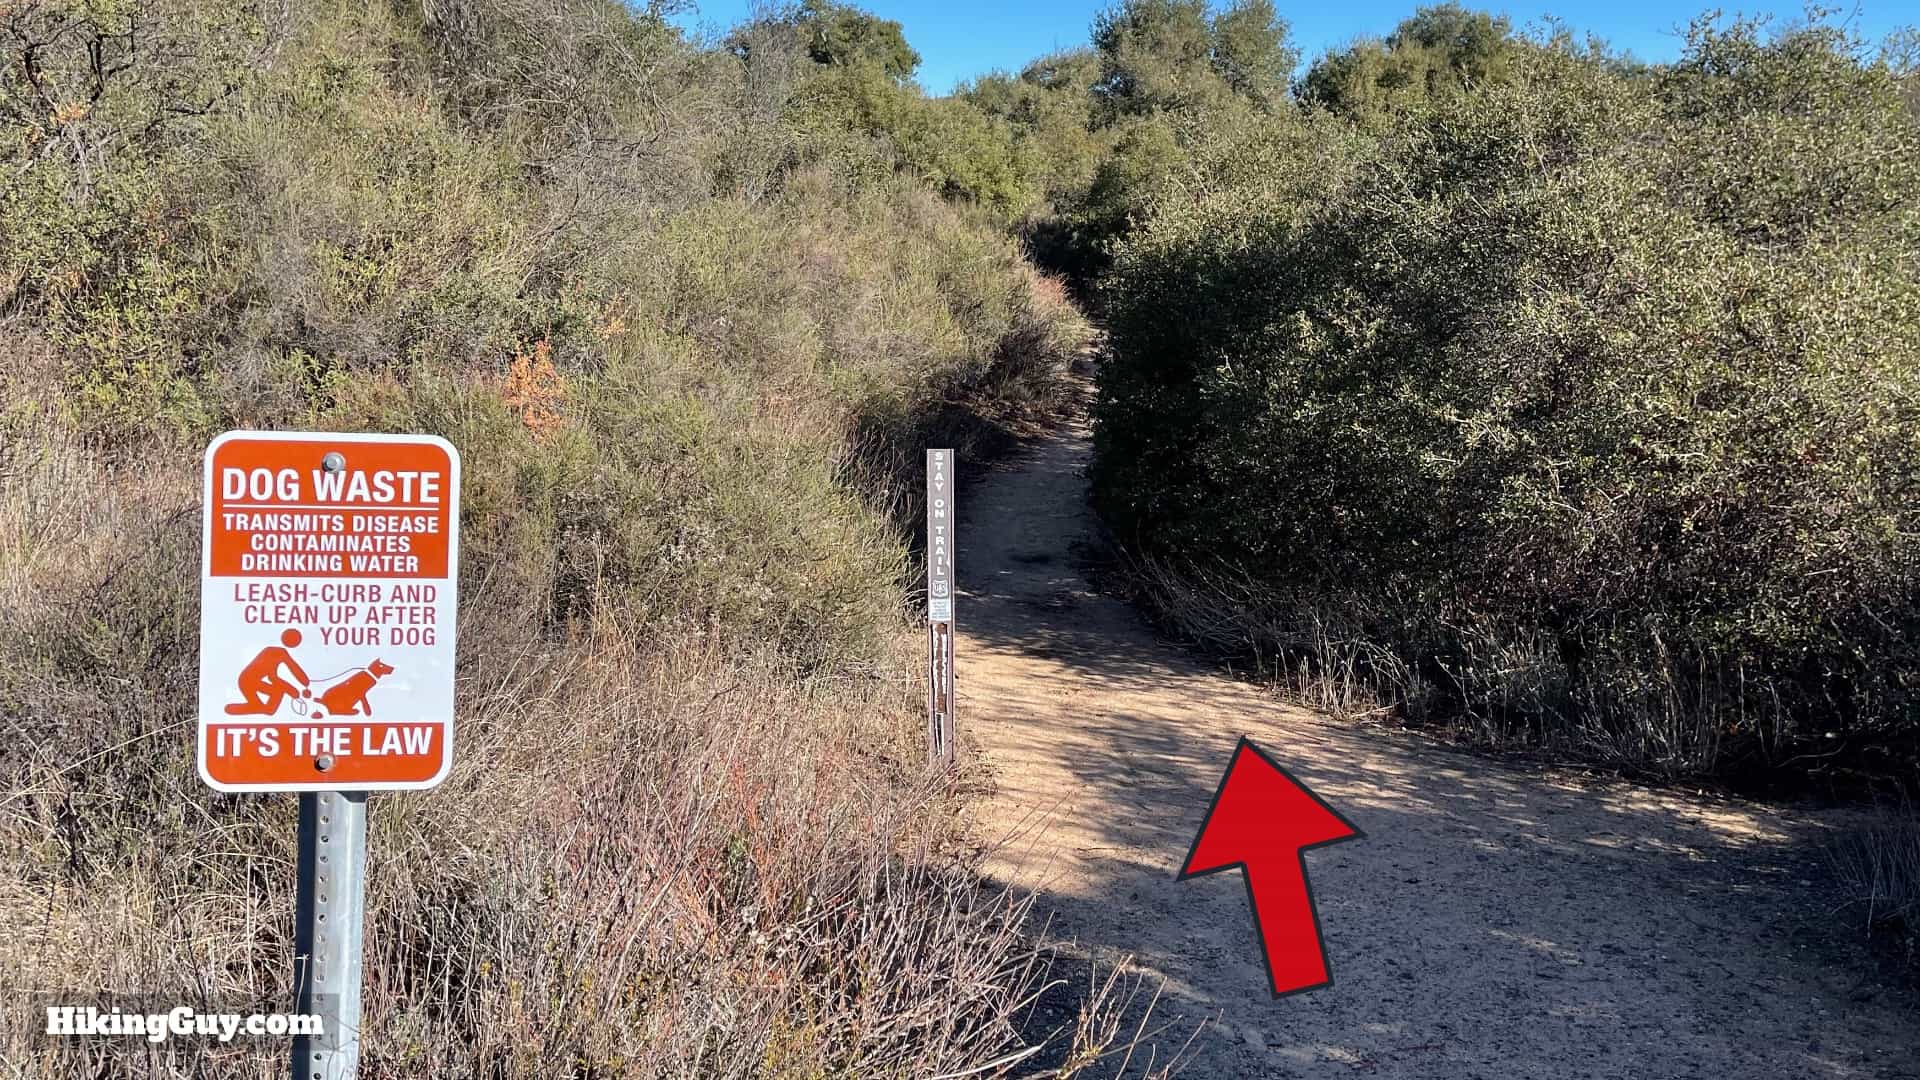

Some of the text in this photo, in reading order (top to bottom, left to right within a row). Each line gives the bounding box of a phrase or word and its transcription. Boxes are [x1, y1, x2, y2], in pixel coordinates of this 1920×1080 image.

[223, 468, 440, 503] DOG WASTE
[935, 452, 944, 575] STAY ON TRAIL
[224, 514, 438, 533] TRANSMITS DISEASE
[251, 535, 411, 553] CONTAMINATES
[241, 554, 419, 572] DRINKING WATER
[235, 584, 437, 603] LEASH-CURB AND
[244, 605, 436, 625] CLEAN UP AFTER
[320, 627, 436, 646] YOUR DOG
[216, 727, 433, 757] IT'S THE LAW
